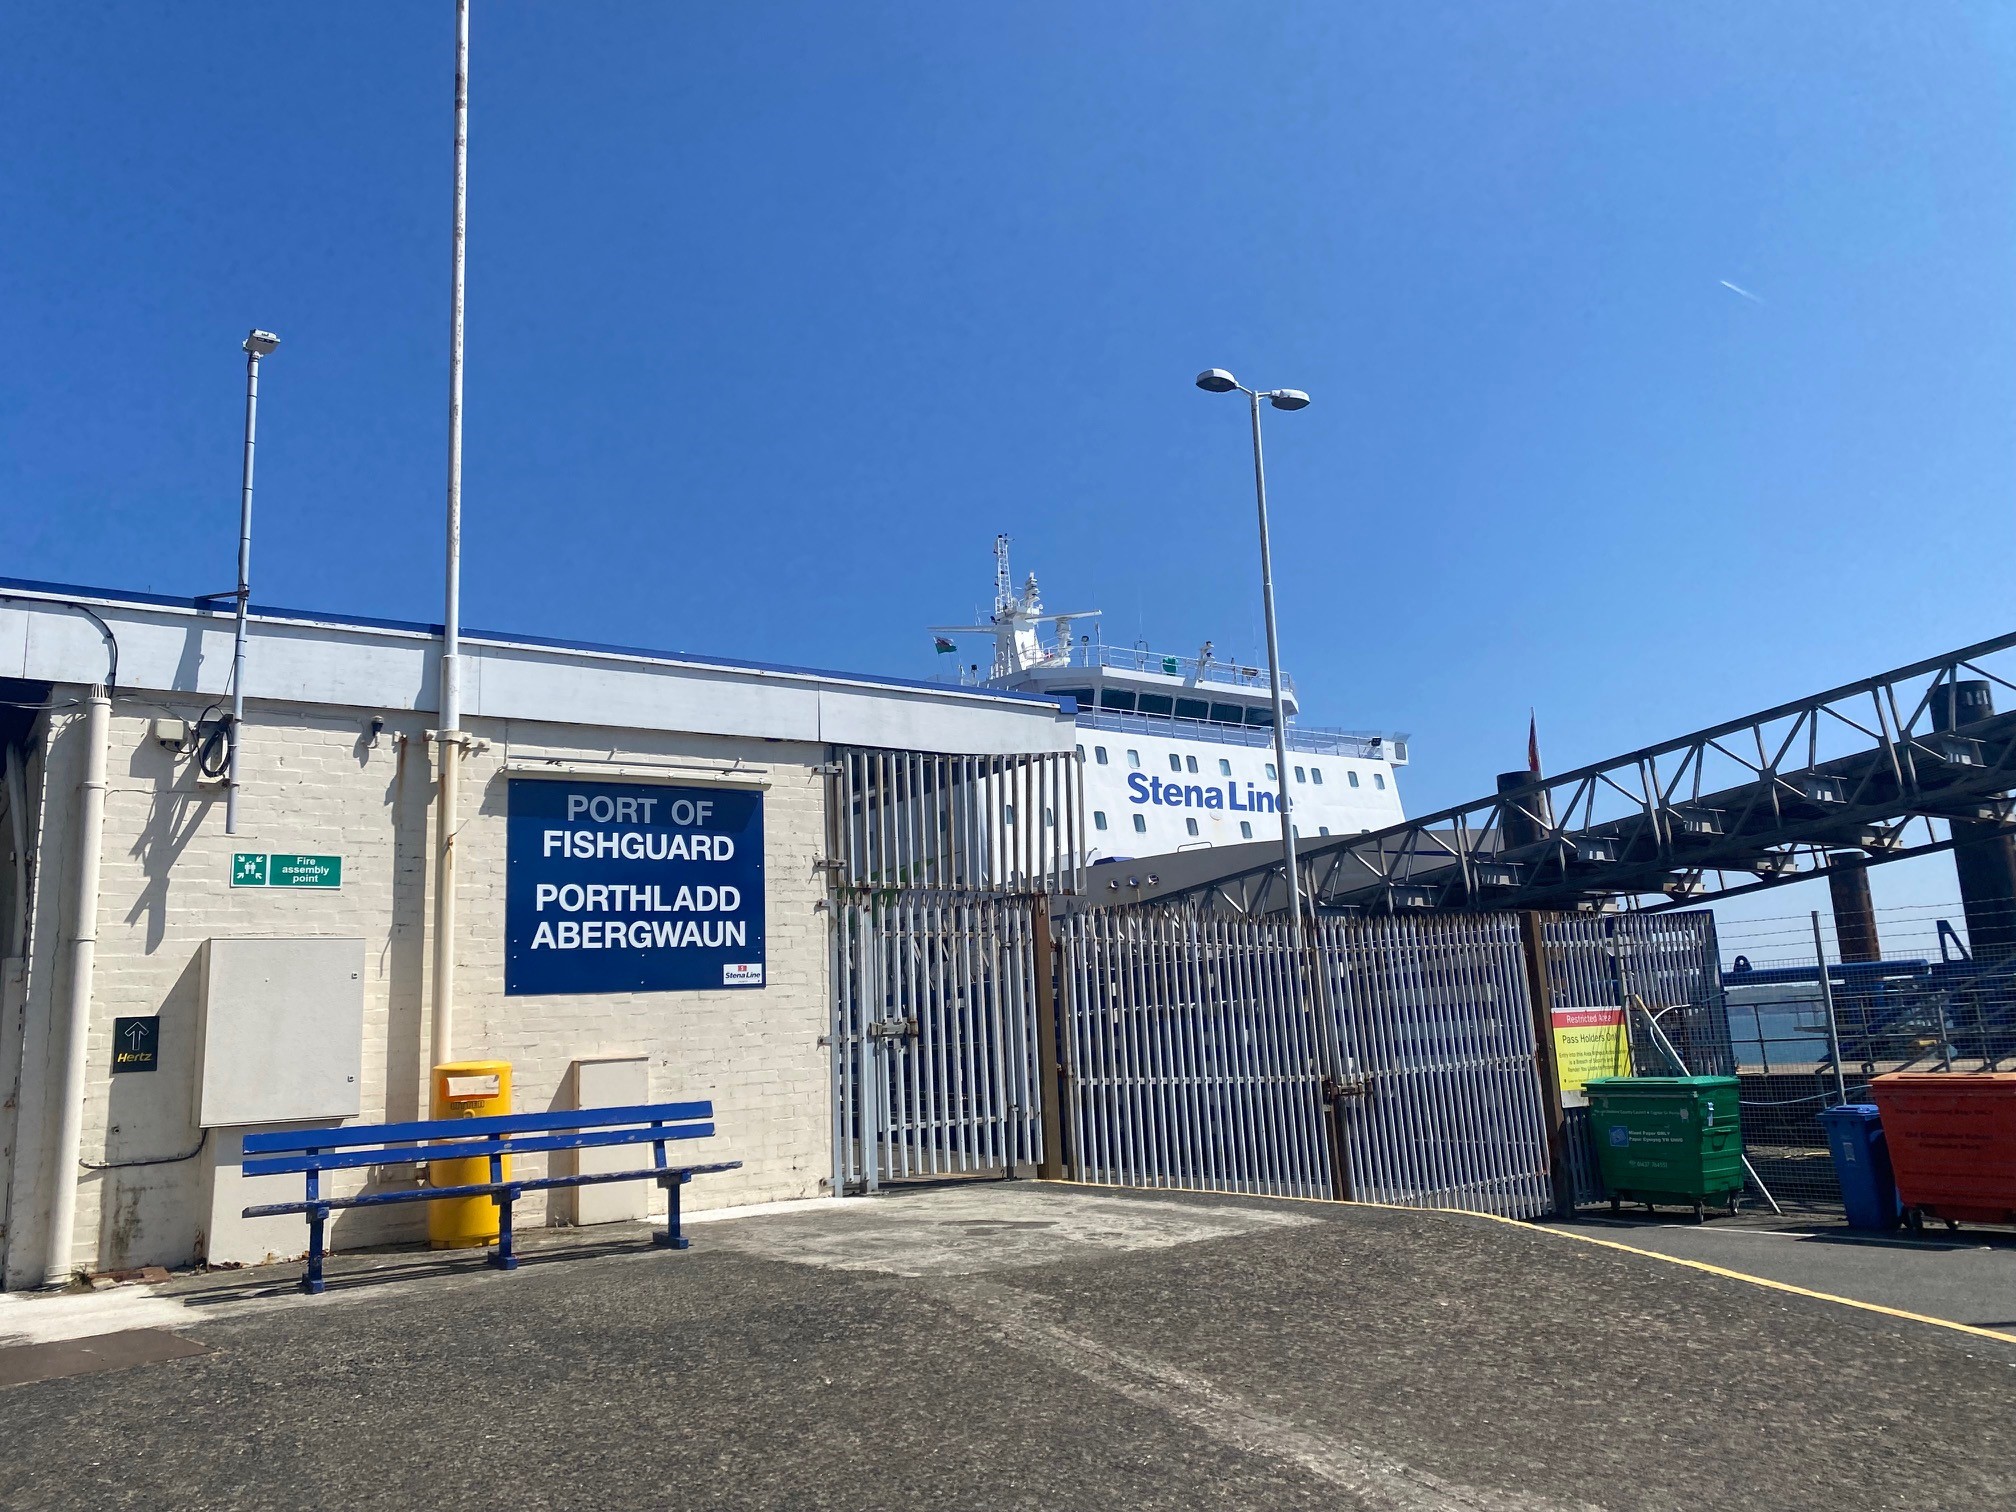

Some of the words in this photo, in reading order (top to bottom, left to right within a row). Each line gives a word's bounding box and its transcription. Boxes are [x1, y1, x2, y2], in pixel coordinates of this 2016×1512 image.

[1127, 772, 1223, 810] Stena
[1229, 781, 1294, 814] Line
[567, 794, 658, 824] PORT
[671, 799, 713, 826] OF
[543, 829, 735, 861] FISHGUARD
[296, 857, 316, 865] Fire
[282, 865, 330, 876] assembly
[292, 875, 319, 884] point
[536, 883, 741, 912] PORTHLADD
[530, 920, 746, 950] ABERGWAUN
[746, 971, 761, 979] Line
[1566, 1014, 1598, 1024] Restricted
[1562, 1034, 1579, 1044] Pass
[1580, 1033, 1605, 1043] Holders
[117, 1053, 152, 1063] Hertz
